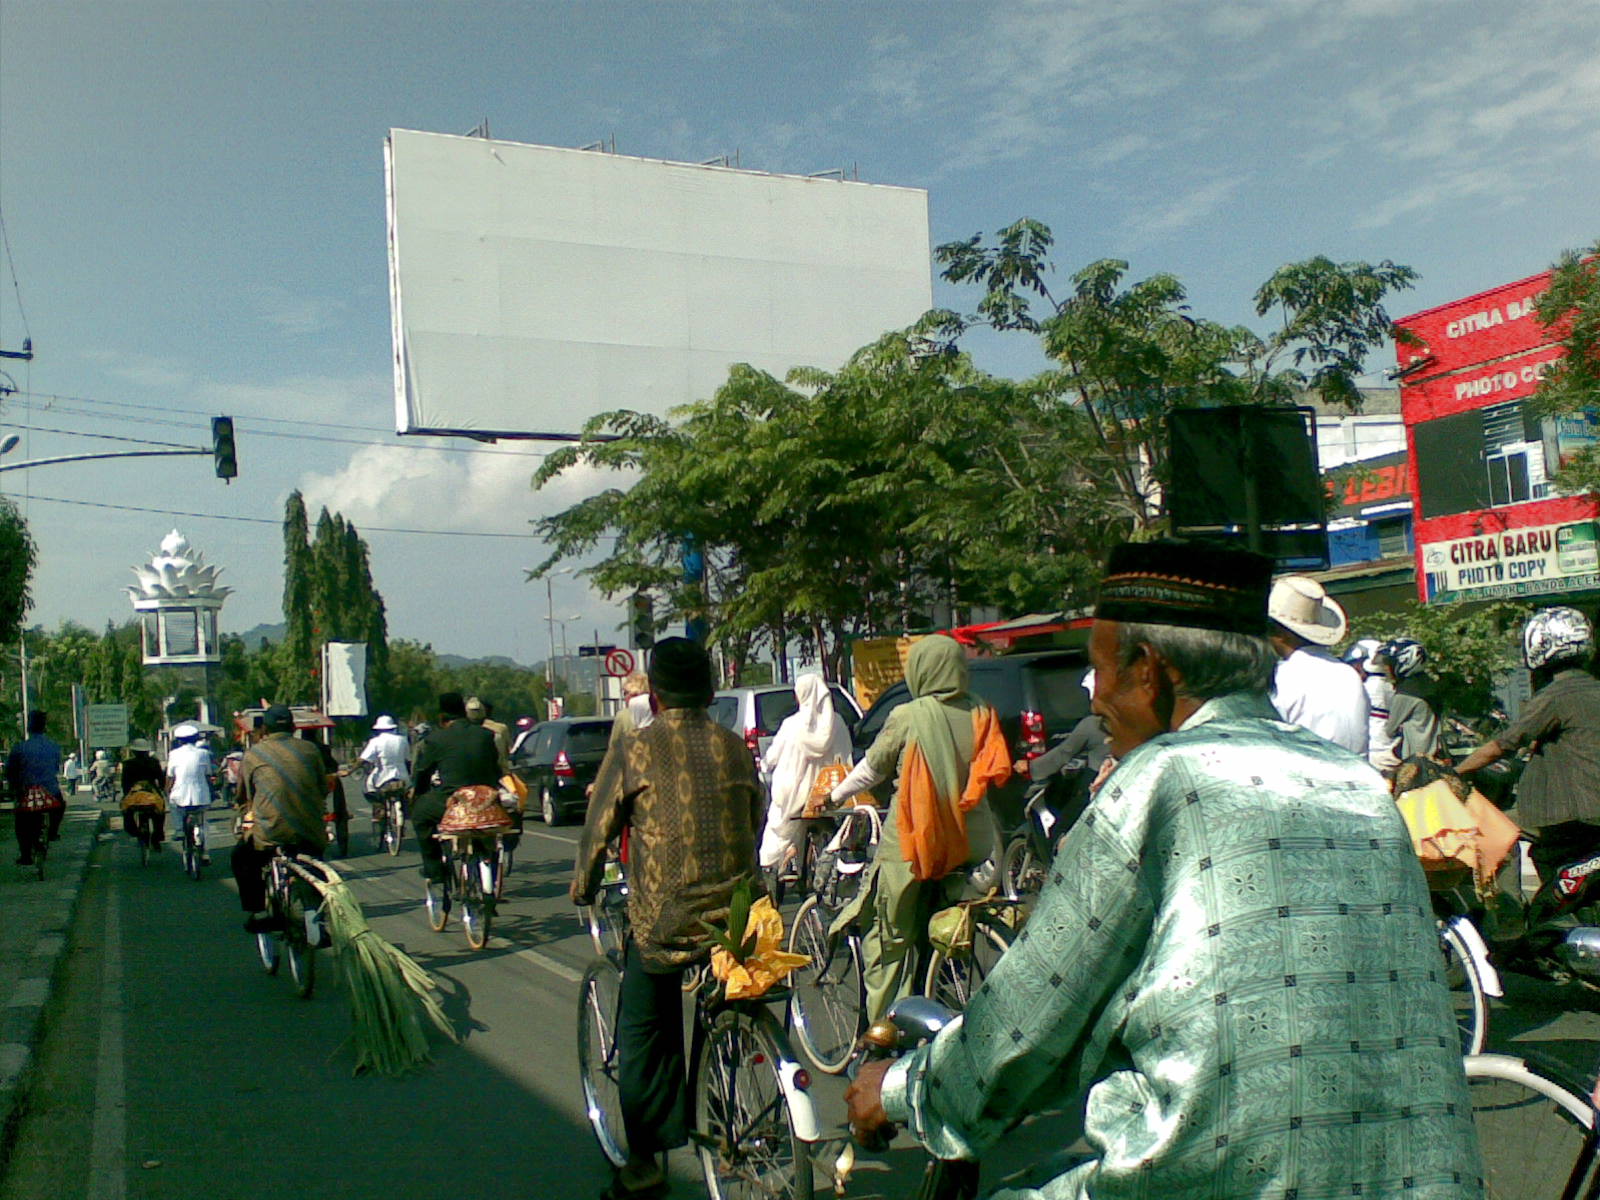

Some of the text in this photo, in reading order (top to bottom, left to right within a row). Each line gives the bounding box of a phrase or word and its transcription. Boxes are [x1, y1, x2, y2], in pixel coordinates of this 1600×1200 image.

[1446, 291, 1548, 339] CITRA BA
[1455, 371, 1518, 401] PHOTO
[1450, 537, 1499, 565] CITRA
[1503, 529, 1552, 557] BARU
[1458, 562, 1504, 585] PHOTO
[1508, 558, 1547, 580] COPY
